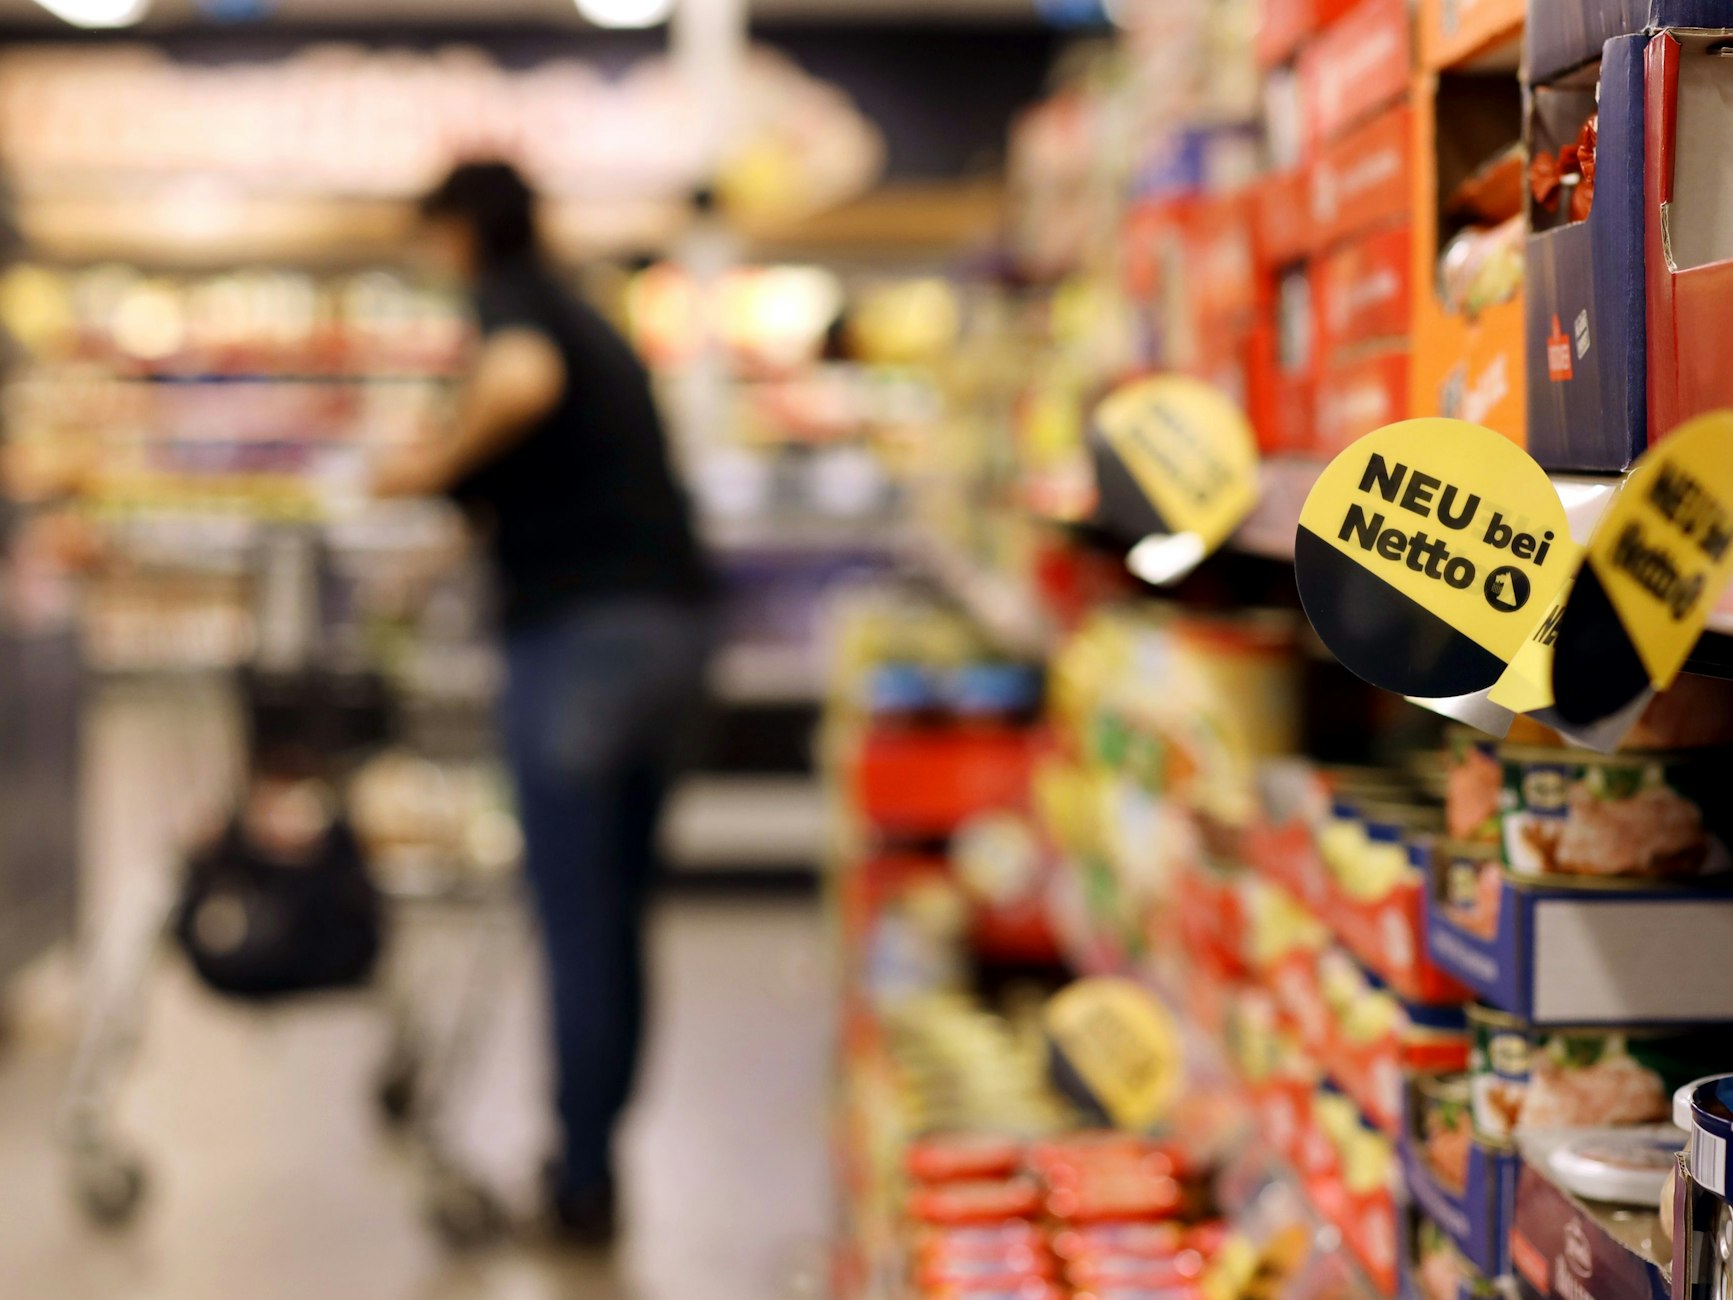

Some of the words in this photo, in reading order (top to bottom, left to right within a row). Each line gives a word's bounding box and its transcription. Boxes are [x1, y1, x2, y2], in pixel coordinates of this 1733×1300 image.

[1338, 503, 1476, 590] Netto
[1358, 452, 1481, 530] NEU
[1483, 511, 1555, 567] bei
